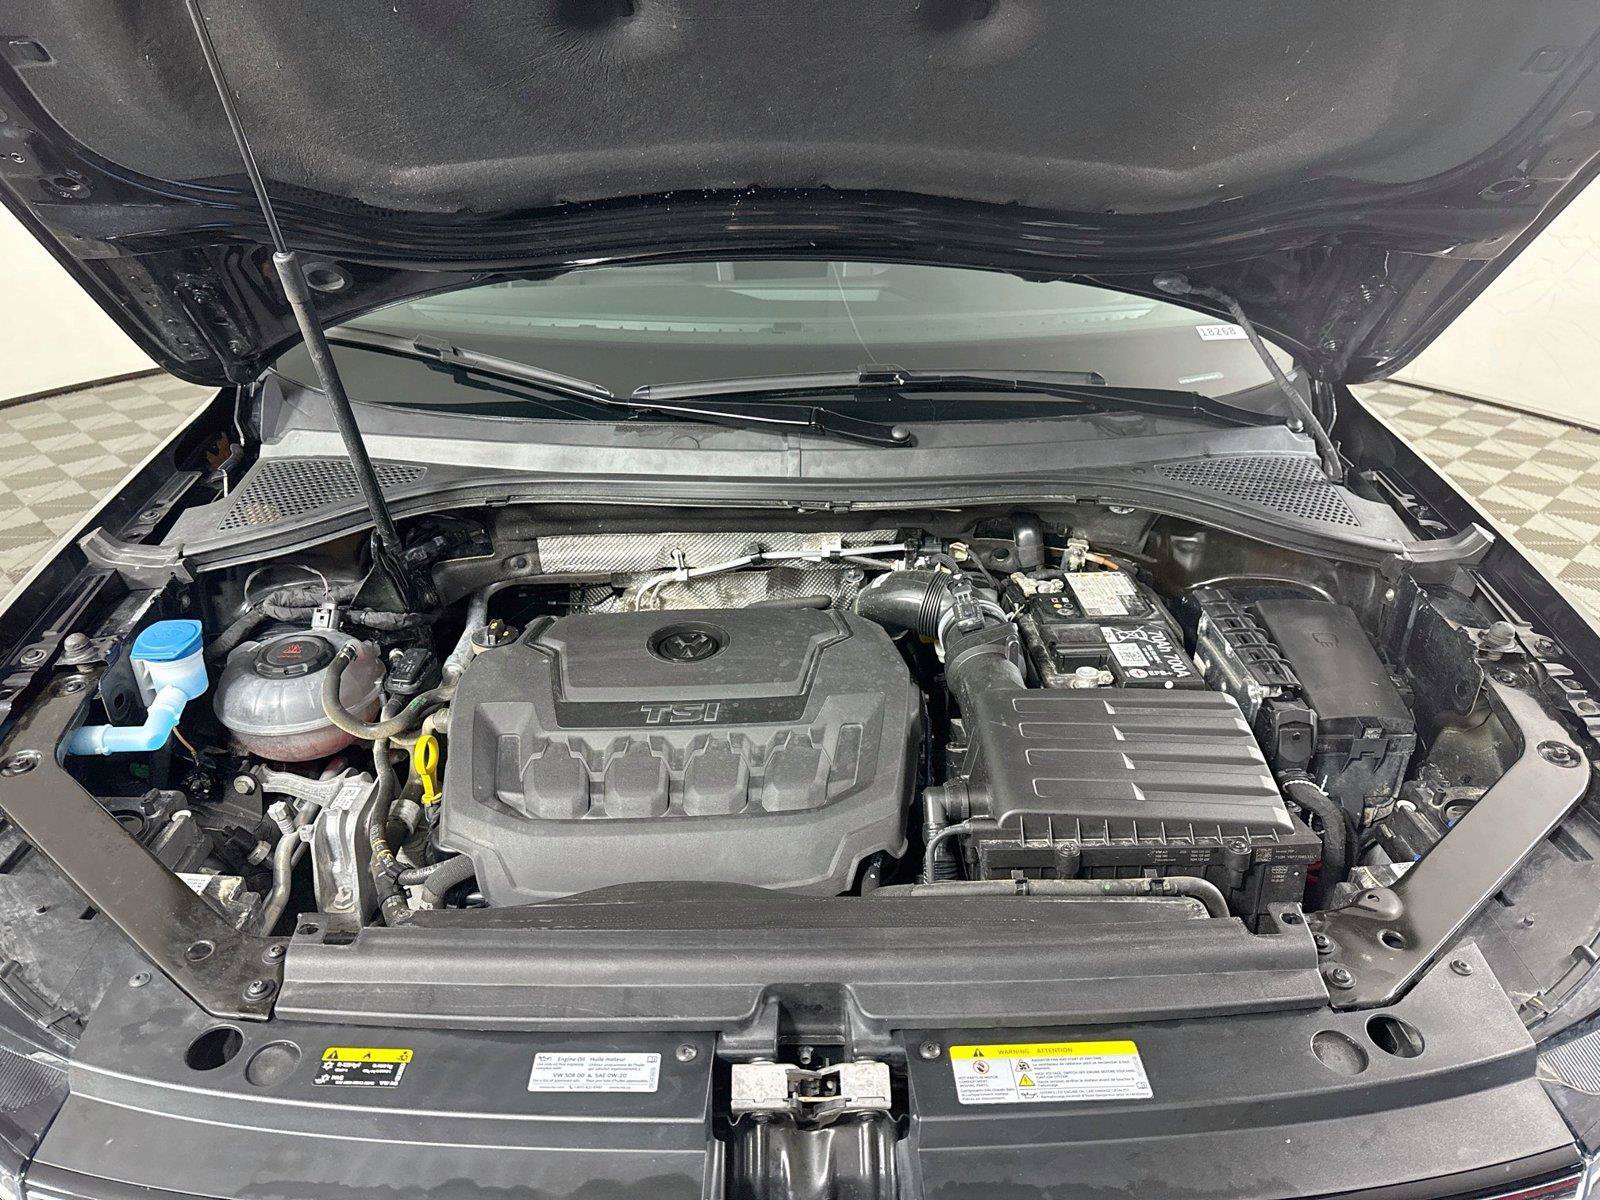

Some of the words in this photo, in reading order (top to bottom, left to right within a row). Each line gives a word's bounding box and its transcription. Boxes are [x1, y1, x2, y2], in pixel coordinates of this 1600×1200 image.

[1200, 327, 1237, 337] 18268
[1148, 630, 1173, 653] 70Ah
[1163, 653, 1191, 678] 700A
[640, 702, 721, 724] TSI
[997, 1048, 1030, 1056] WARNING
[1036, 1046, 1073, 1054] ATTENTION
